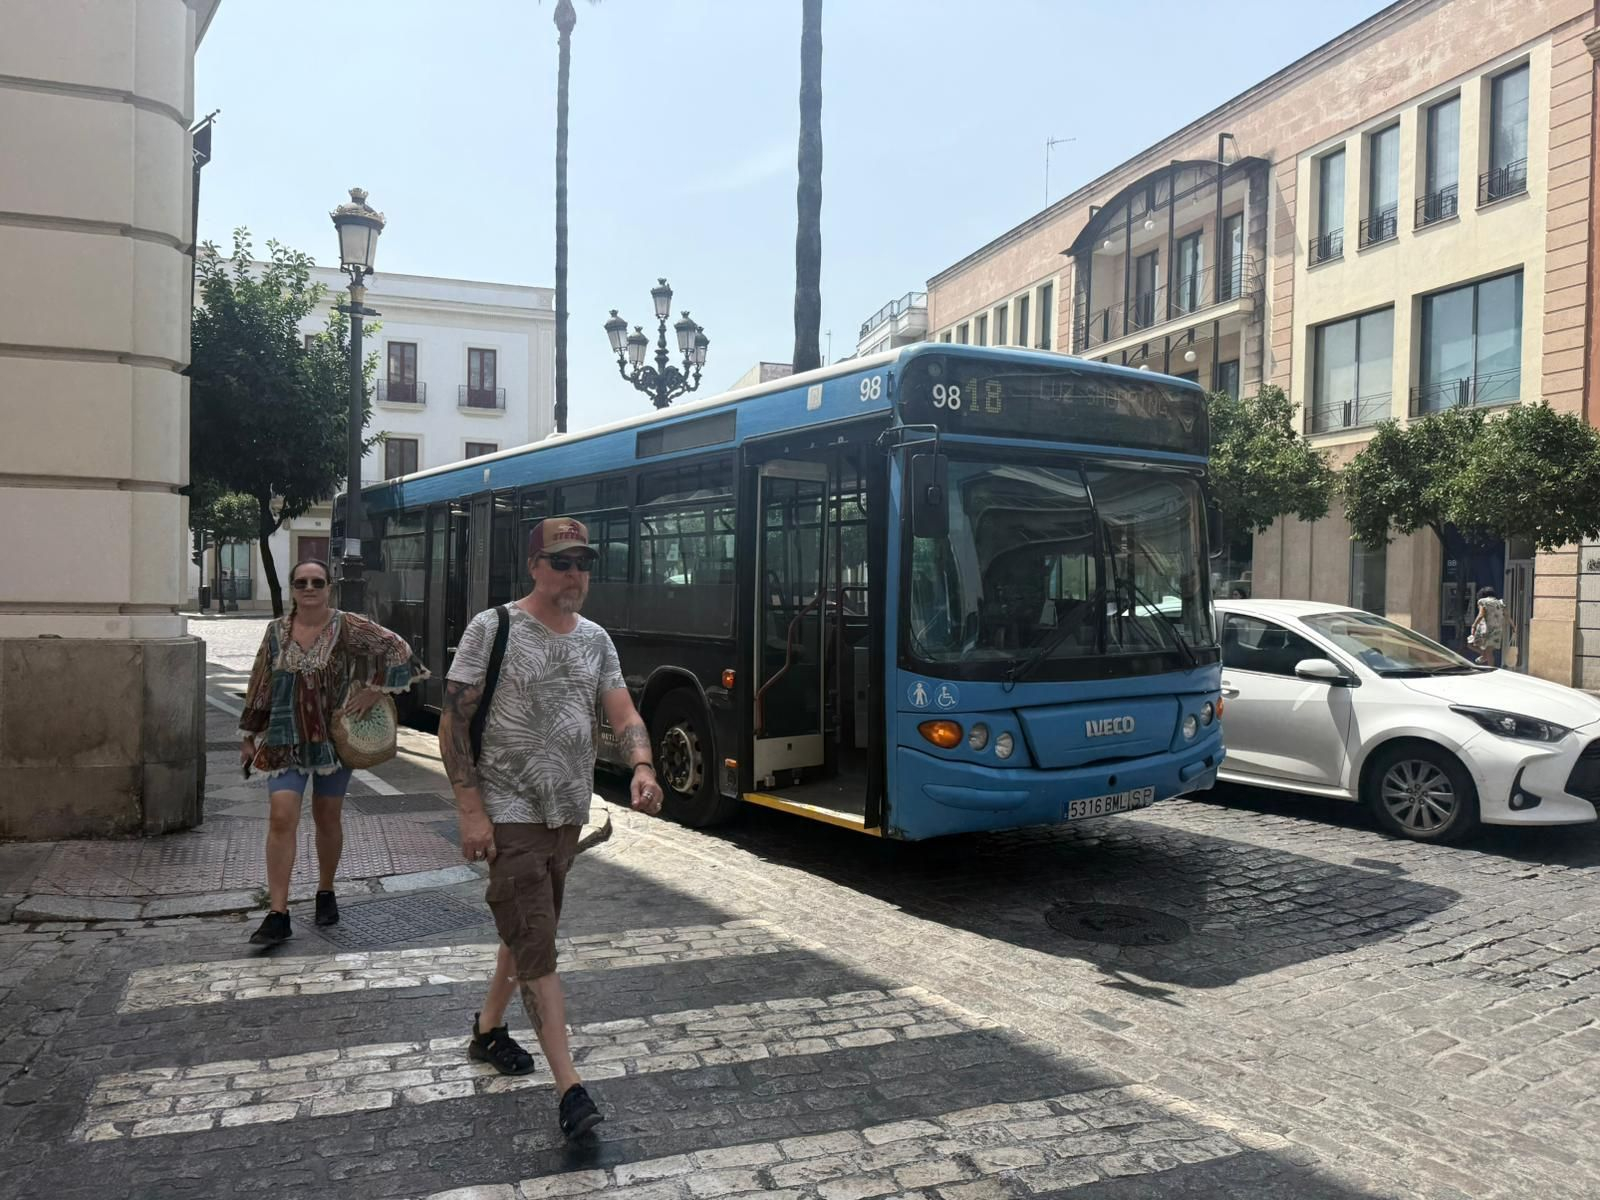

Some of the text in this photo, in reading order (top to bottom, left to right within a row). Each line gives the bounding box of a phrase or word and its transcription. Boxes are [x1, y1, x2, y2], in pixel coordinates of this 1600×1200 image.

[860, 375, 882, 402] 98
[932, 384, 961, 410] 98
[965, 378, 1002, 413] 18
[1085, 716, 1135, 737] IVECO
[1071, 799, 1102, 818] 5316
[1105, 794, 1127, 812] BML
